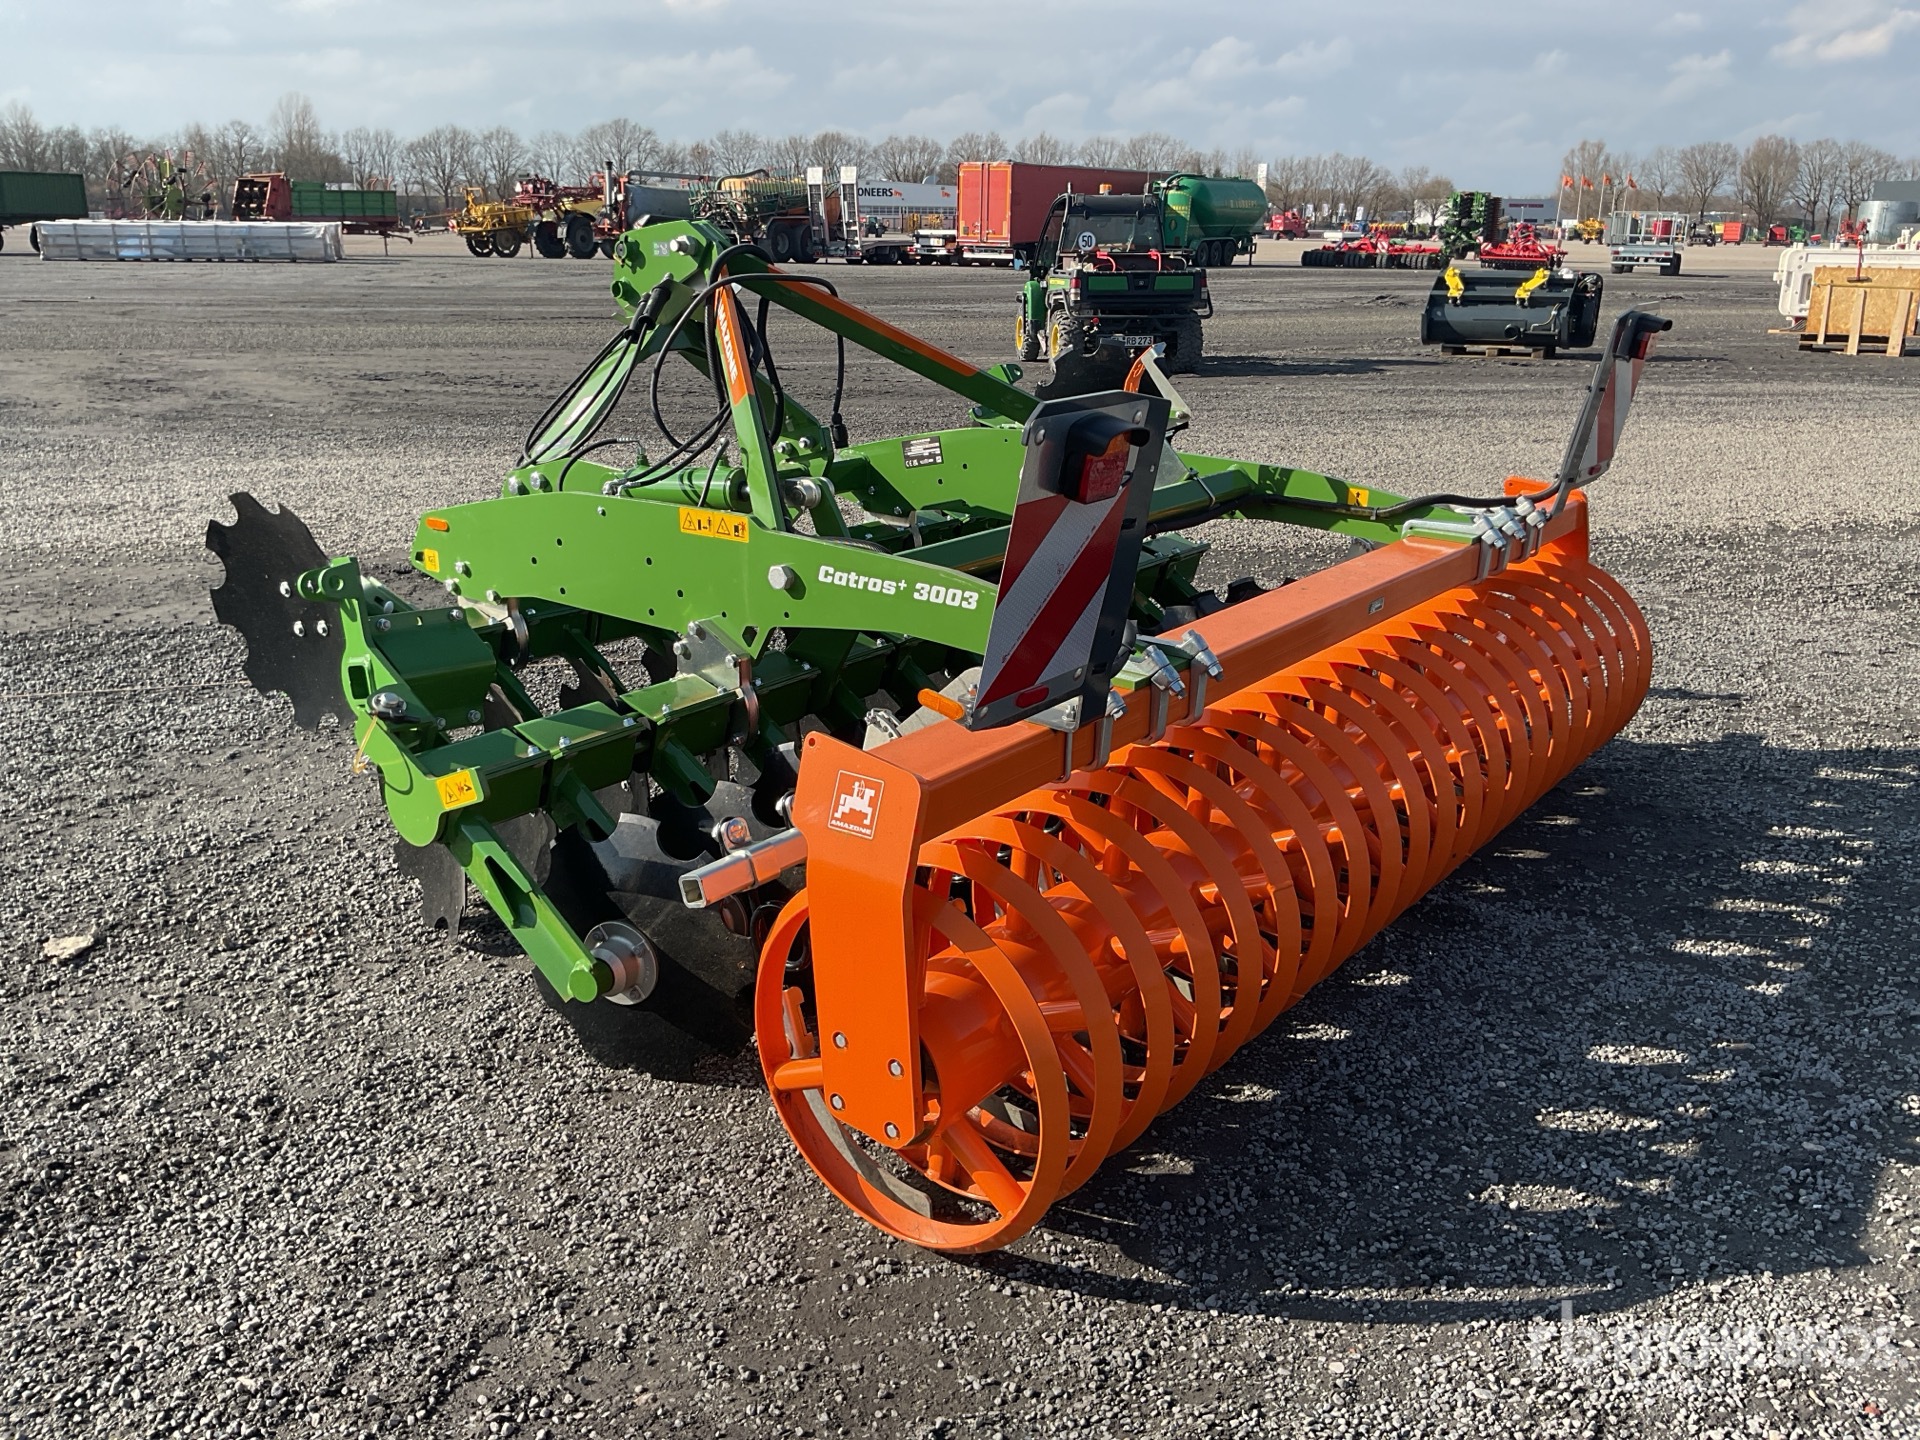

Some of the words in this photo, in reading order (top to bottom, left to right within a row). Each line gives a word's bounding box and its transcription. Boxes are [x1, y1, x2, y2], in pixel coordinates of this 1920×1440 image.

[1082, 235, 1092, 248] 50
[1126, 337, 1137, 346] RB
[1137, 336, 1152, 346] 273
[913, 582, 979, 610] 3003
[831, 819, 872, 836] AMAZONE
